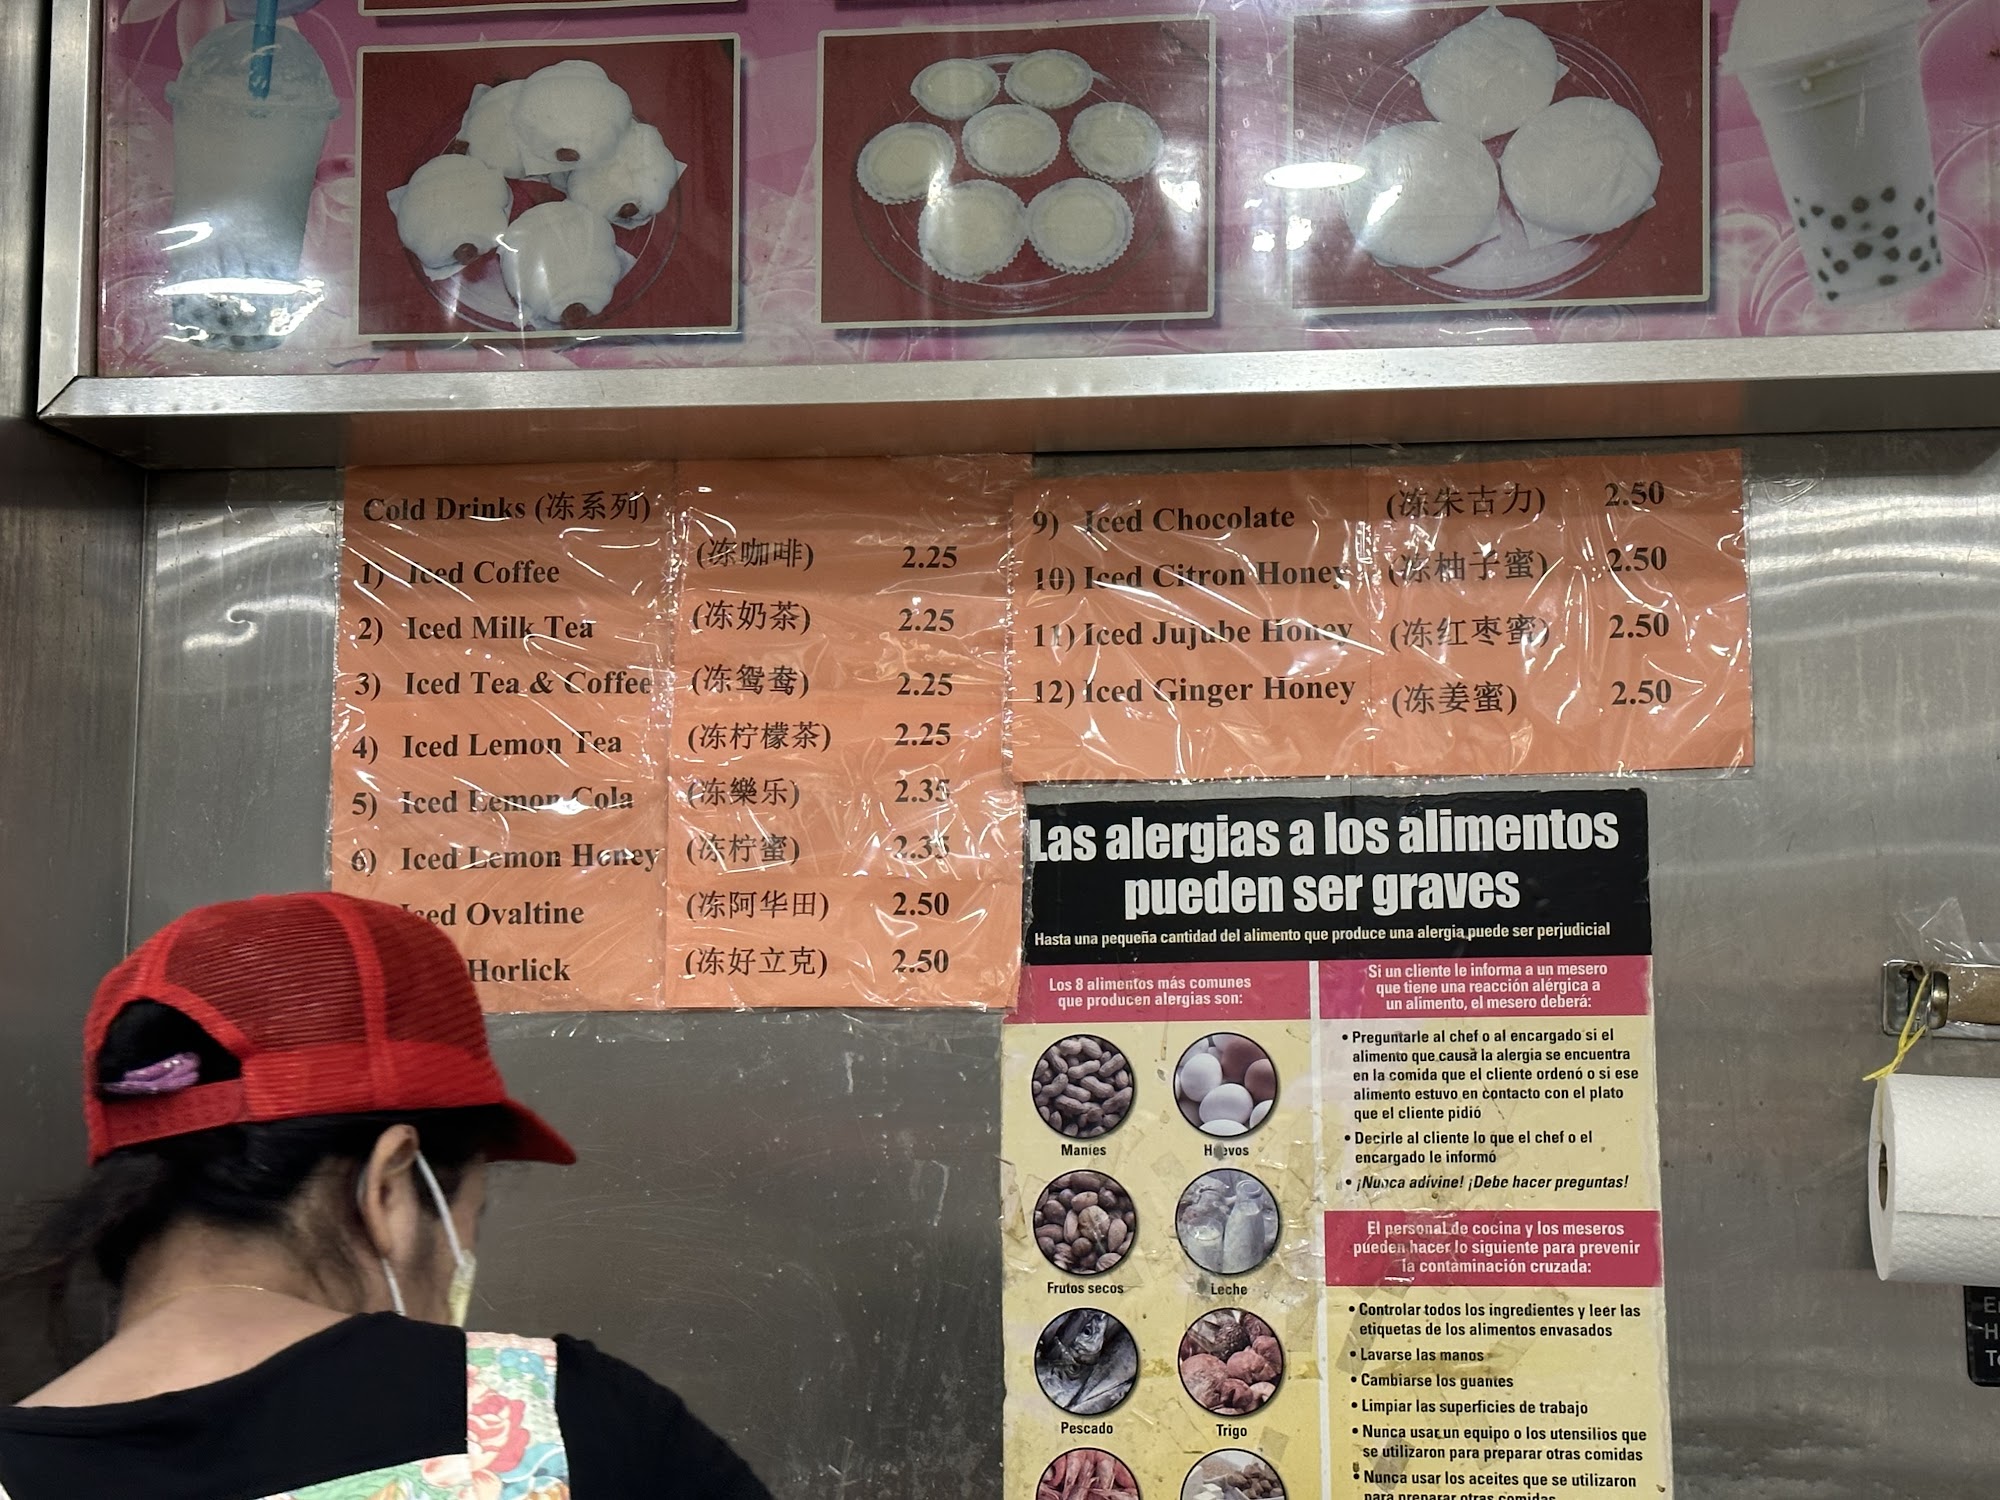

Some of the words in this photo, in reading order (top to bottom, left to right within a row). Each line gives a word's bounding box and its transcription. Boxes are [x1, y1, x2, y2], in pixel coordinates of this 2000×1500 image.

[363, 498, 425, 522] Cold
[435, 498, 525, 521] Drinks
[534, 492, 649, 524] (冻系列)
[1387, 484, 1545, 518] (冻朱古力)
[1605, 481, 1664, 507] 2.50
[1033, 510, 1059, 539] 9)
[1086, 509, 1142, 533] Iced
[1153, 506, 1295, 532] Chocolate
[696, 537, 814, 571] (冻咖啡)
[901, 546, 958, 569] 2.25
[1388, 547, 1548, 588] (冻柚子蜜)
[1607, 546, 1667, 572] 2.50
[361, 563, 384, 588] 1)
[408, 562, 463, 584] Iced
[473, 560, 559, 584] Coffee
[1033, 567, 1075, 594] 10)
[1083, 565, 1142, 589] Iced
[1153, 563, 1245, 588] Citron
[1258, 561, 1349, 590] Honey
[358, 618, 383, 645] 2)
[407, 617, 462, 640] Iced
[471, 616, 534, 639] Milk
[544, 616, 594, 639] Tea
[692, 600, 811, 634] (冻奶茶)
[898, 609, 955, 632] 2.25
[1033, 624, 1075, 651] 11)
[1083, 623, 1142, 646] Iced
[1152, 620, 1251, 650] Jujube
[1262, 620, 1352, 649] Honey
[1390, 614, 1549, 651] (冻红枣蜜)
[1609, 613, 1669, 639] 2.50
[355, 673, 381, 700] 3)
[405, 672, 460, 695] Iced
[471, 672, 520, 694] Tea
[530, 672, 554, 694] &
[564, 671, 652, 694] Coffee
[691, 663, 809, 698] (冻鸳鸯)
[896, 673, 953, 696] 2.25
[1033, 680, 1075, 709] 12)
[1083, 679, 1142, 702] Iced
[1155, 678, 1253, 707] Ginger
[1263, 677, 1356, 704] Honey
[1392, 681, 1517, 718] (冻姜蜜)
[1612, 680, 1672, 705] 2.50
[352, 736, 378, 764] 4)
[402, 735, 458, 759] Iced
[469, 733, 561, 757] Lemon
[571, 730, 622, 754] Tea
[688, 721, 831, 753] (冻柠檬茶)
[894, 722, 951, 746] 2.25
[352, 792, 378, 820] 5)
[401, 790, 457, 814] Iced
[468, 789, 561, 813] Lemon
[573, 787, 634, 810] Cola
[895, 779, 952, 803] 2.35
[687, 834, 800, 864] (冻柠蜜)
[894, 835, 951, 859] 2.35
[1030, 819, 1097, 862] Las
[1106, 815, 1280, 863] alergias
[1290, 819, 1314, 856] a
[1324, 811, 1389, 854] los
[1399, 809, 1619, 853] alimentos
[352, 848, 377, 876] 6)
[401, 847, 457, 871] Iced
[468, 846, 561, 869] Lemon
[572, 843, 659, 872] Honey
[686, 890, 829, 921] (冻阿华田)
[893, 892, 949, 916] 2.50
[1125, 870, 1283, 920] pueden
[1293, 874, 1362, 913] ser
[1372, 870, 1520, 915] graves
[467, 901, 584, 926] Ovaltine
[1035, 933, 1071, 946] Hasta
[1075, 935, 1098, 945] una
[1102, 931, 1157, 948] pequeña
[1161, 930, 1216, 943] cantidad
[1220, 930, 1240, 943] del
[1244, 929, 1300, 942] alimento
[1304, 931, 1328, 943] que
[1332, 927, 1386, 943] produce
[1390, 929, 1414, 939] una
[1468, 925, 1509, 941] puede
[1512, 927, 1534, 937] ser
[1537, 922, 1610, 941] perjudicial
[468, 958, 571, 982] Horlick
[685, 948, 828, 978] (冻好立克)
[892, 950, 948, 973] 2.50
[1369, 965, 1381, 977] Si
[1385, 966, 1401, 977] un
[1405, 964, 1451, 977] cliente
[1455, 964, 1467, 976] le
[1470, 963, 1521, 976] informa
[1525, 966, 1533, 976] a
[1537, 965, 1554, 975] un
[1557, 965, 1607, 975] mesero
[1049, 979, 1072, 992] Los
[1076, 978, 1083, 991] 8
[1087, 977, 1153, 991] alimentos
[1157, 976, 1185, 989] más
[1190, 978, 1251, 989] comunes
[1376, 982, 1400, 996] que
[1404, 981, 1437, 993] tiene
[1441, 982, 1465, 992] una
[1469, 979, 1528, 992] reacción
[1532, 978, 1588, 994] alérgica
[1592, 982, 1600, 991] a
[1058, 996, 1083, 1010] que
[1086, 994, 1150, 1009] producen
[1154, 992, 1210, 1008] alergias
[1214, 993, 1242, 1004] son:
[1386, 999, 1402, 1010] un
[1406, 996, 1468, 1012] alimento,
[1471, 996, 1483, 1009] el
[1487, 998, 1536, 1008] mesero
[1541, 995, 1592, 1008] deberá:
[1204, 1144, 1249, 1156] Hevos
[1355, 1132, 1402, 1144] Decirle
[1407, 1131, 1418, 1144] al
[1423, 1131, 1468, 1144] cliente
[1473, 1131, 1485, 1144] lo
[1490, 1133, 1514, 1147] que
[1518, 1131, 1530, 1144] el
[1535, 1131, 1564, 1144] chef
[1568, 1134, 1575, 1144] o
[1580, 1130, 1592, 1144] el
[1355, 1150, 1425, 1165] encargado
[1429, 1150, 1442, 1163] le
[1446, 1149, 1496, 1163] informó
[1357, 1176, 1405, 1192] ¡Nunca
[1409, 1175, 1464, 1189] adivine!
[1468, 1176, 1508, 1191] ¡Debe
[1512, 1176, 1551, 1189] hacer
[1554, 1175, 1629, 1191] preguntas!
[1402, 1260, 1415, 1273] la
[1419, 1259, 1526, 1273] contaminación
[1530, 1260, 1591, 1273] cruzada:
[1048, 1282, 1084, 1294] Frutos
[1089, 1284, 1124, 1294] secos
[1211, 1283, 1248, 1295] Leche
[1361, 1349, 1412, 1361] Lavarse
[1416, 1349, 1436, 1361] las
[1440, 1351, 1484, 1361] manos
[1361, 1374, 1432, 1387] Cambiarse
[1436, 1374, 1456, 1387] los
[1460, 1376, 1514, 1389] guantes
[1061, 1422, 1113, 1434] Pescado
[1216, 1424, 1247, 1439] Trigo
